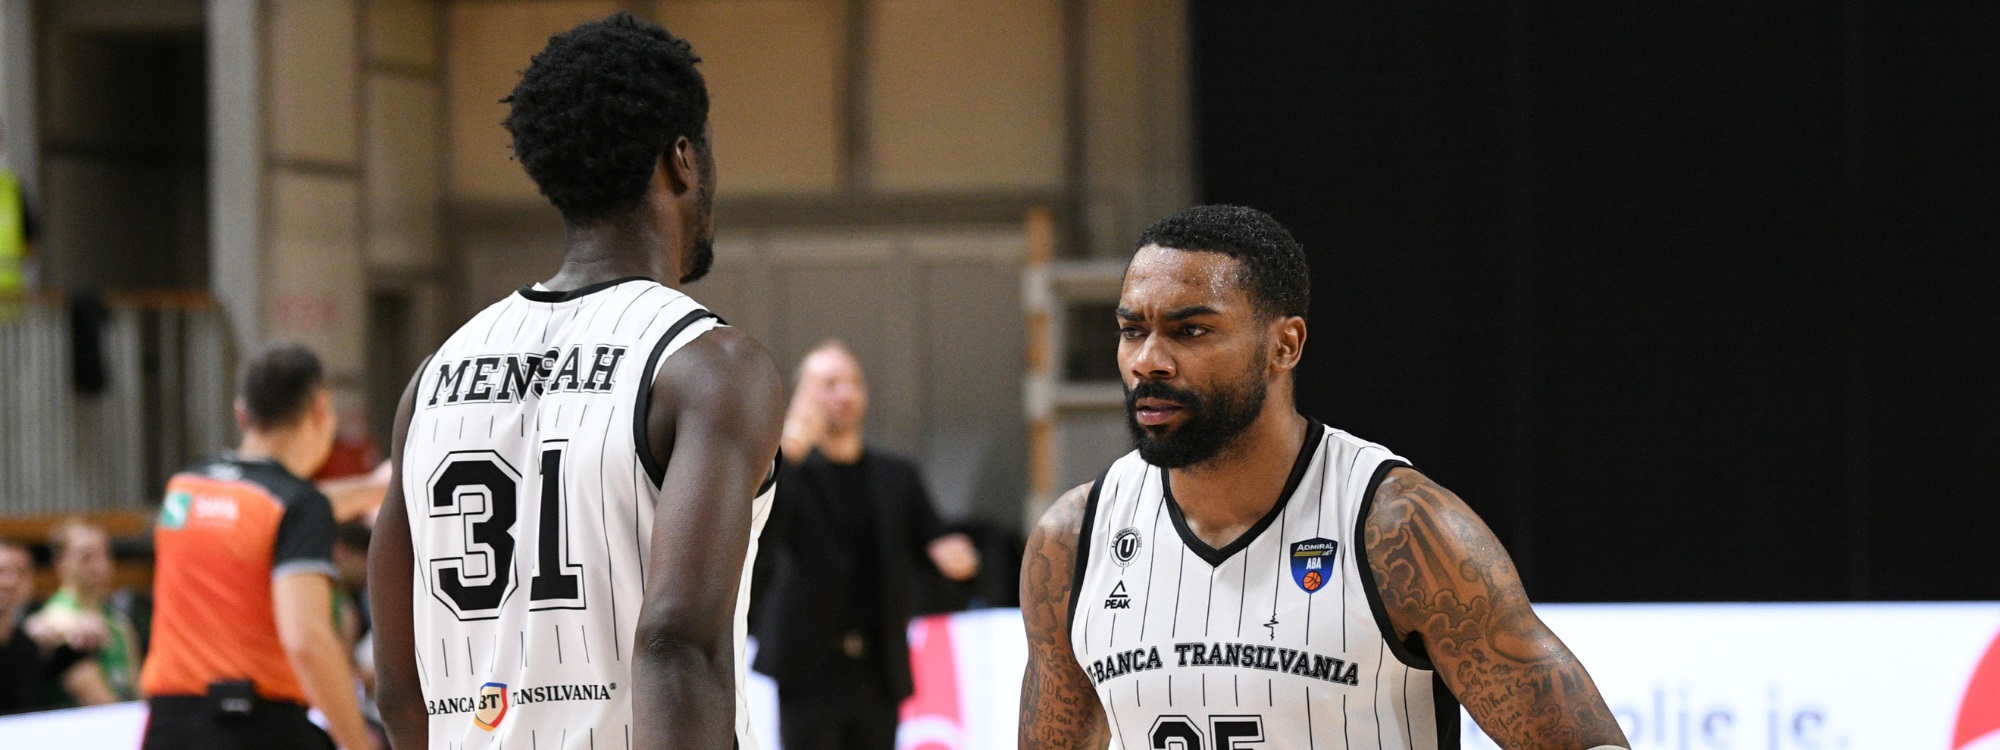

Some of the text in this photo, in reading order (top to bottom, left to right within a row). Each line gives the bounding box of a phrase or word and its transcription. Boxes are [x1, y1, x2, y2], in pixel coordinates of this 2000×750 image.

[425, 343, 629, 410] MENSAH
[426, 438, 587, 622] 31
[1120, 538, 1135, 559] U
[1296, 542, 1334, 551] ADMIRAL
[1305, 556, 1322, 570] ABA
[1104, 599, 1131, 610] PEAK
[1174, 642, 1360, 687] TRANSILVANIA
[429, 697, 475, 715] BANCA
